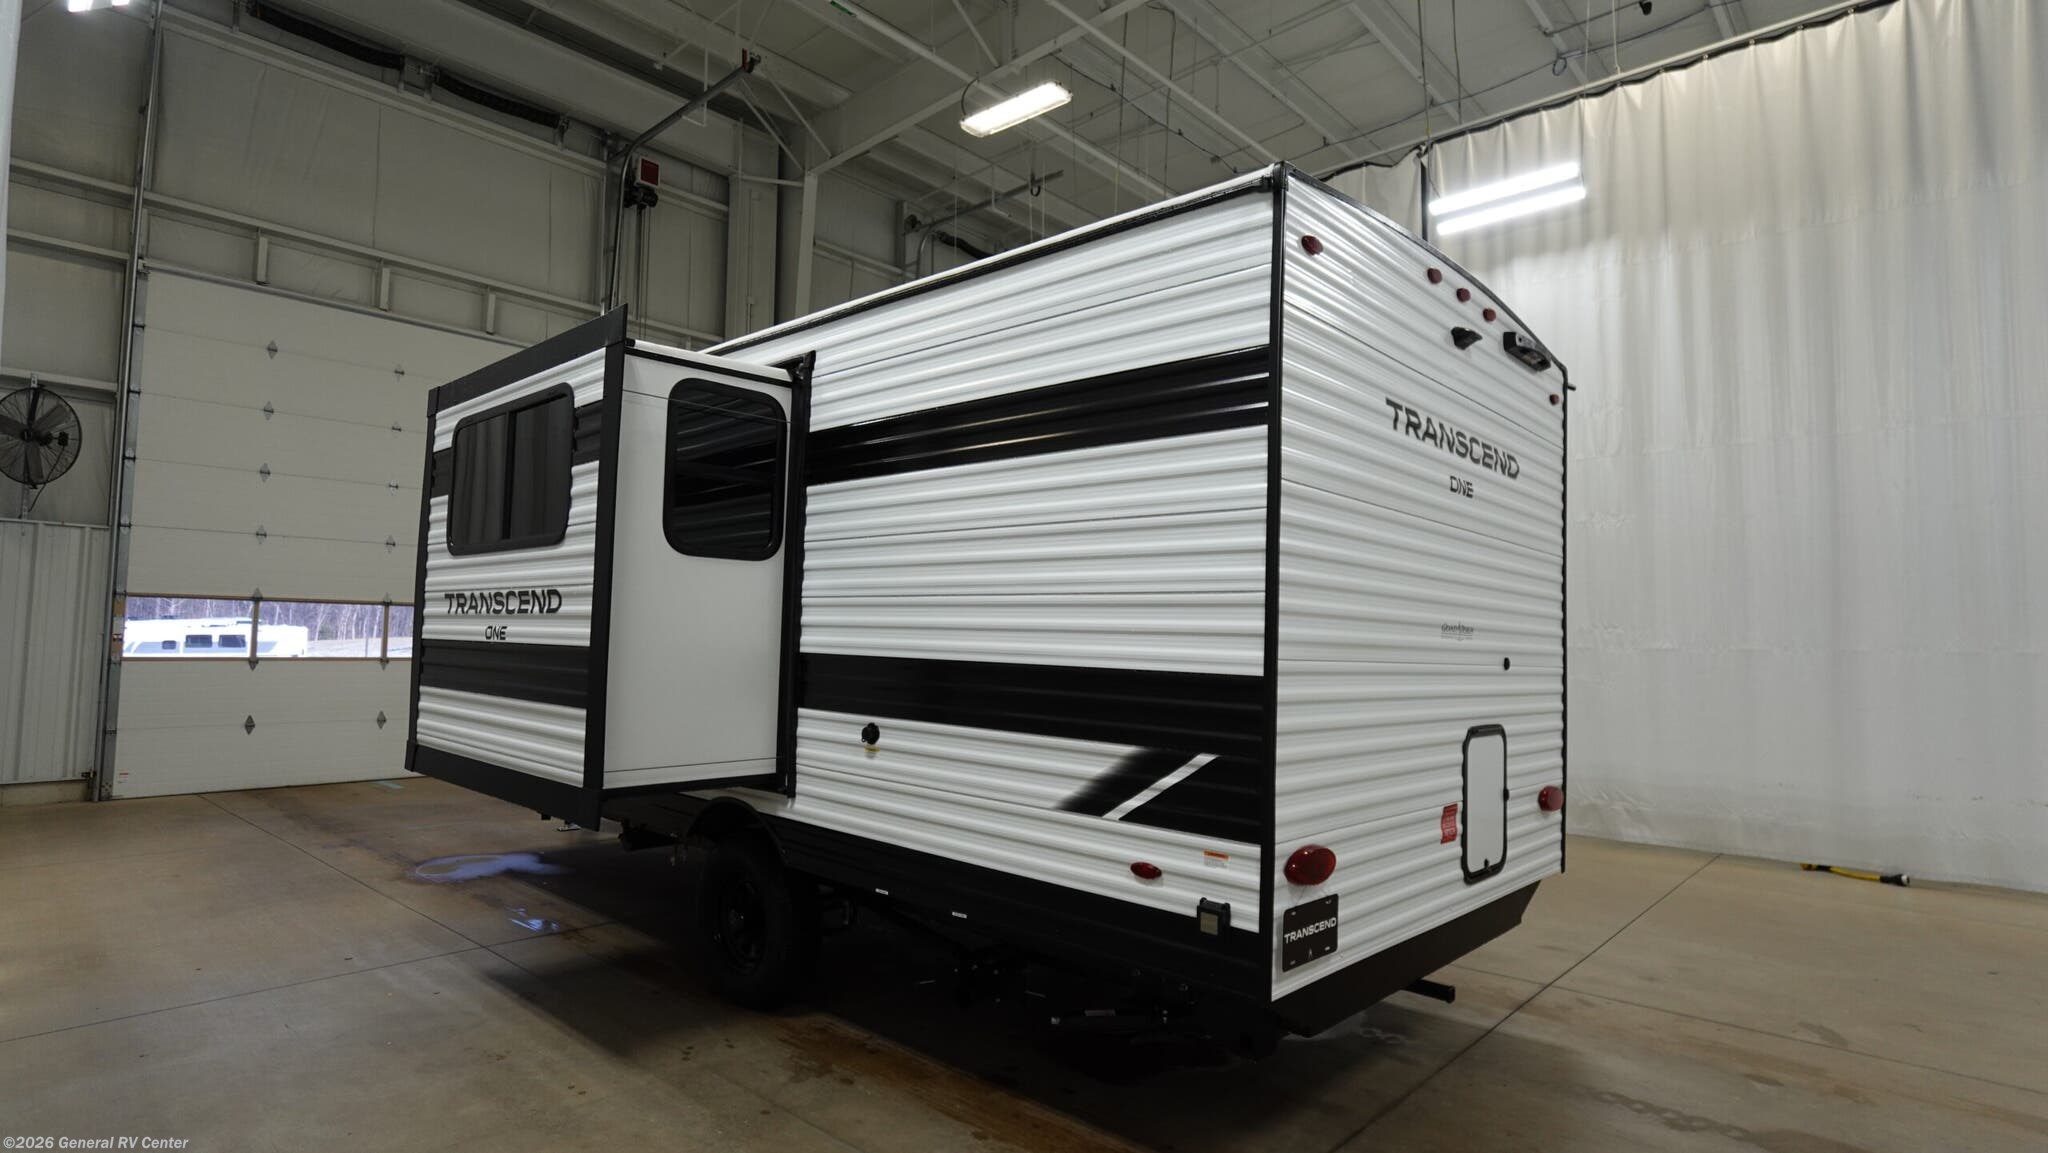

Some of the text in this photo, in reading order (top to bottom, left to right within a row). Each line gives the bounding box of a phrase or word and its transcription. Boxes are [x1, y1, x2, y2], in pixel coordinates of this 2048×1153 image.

[1385, 397, 1520, 480] TRANSCEND
[1449, 475, 1474, 499] ONE
[444, 588, 563, 615] TRANSCEND
[485, 625, 508, 641] ONE
[1284, 916, 1337, 944] TRANSCEND
